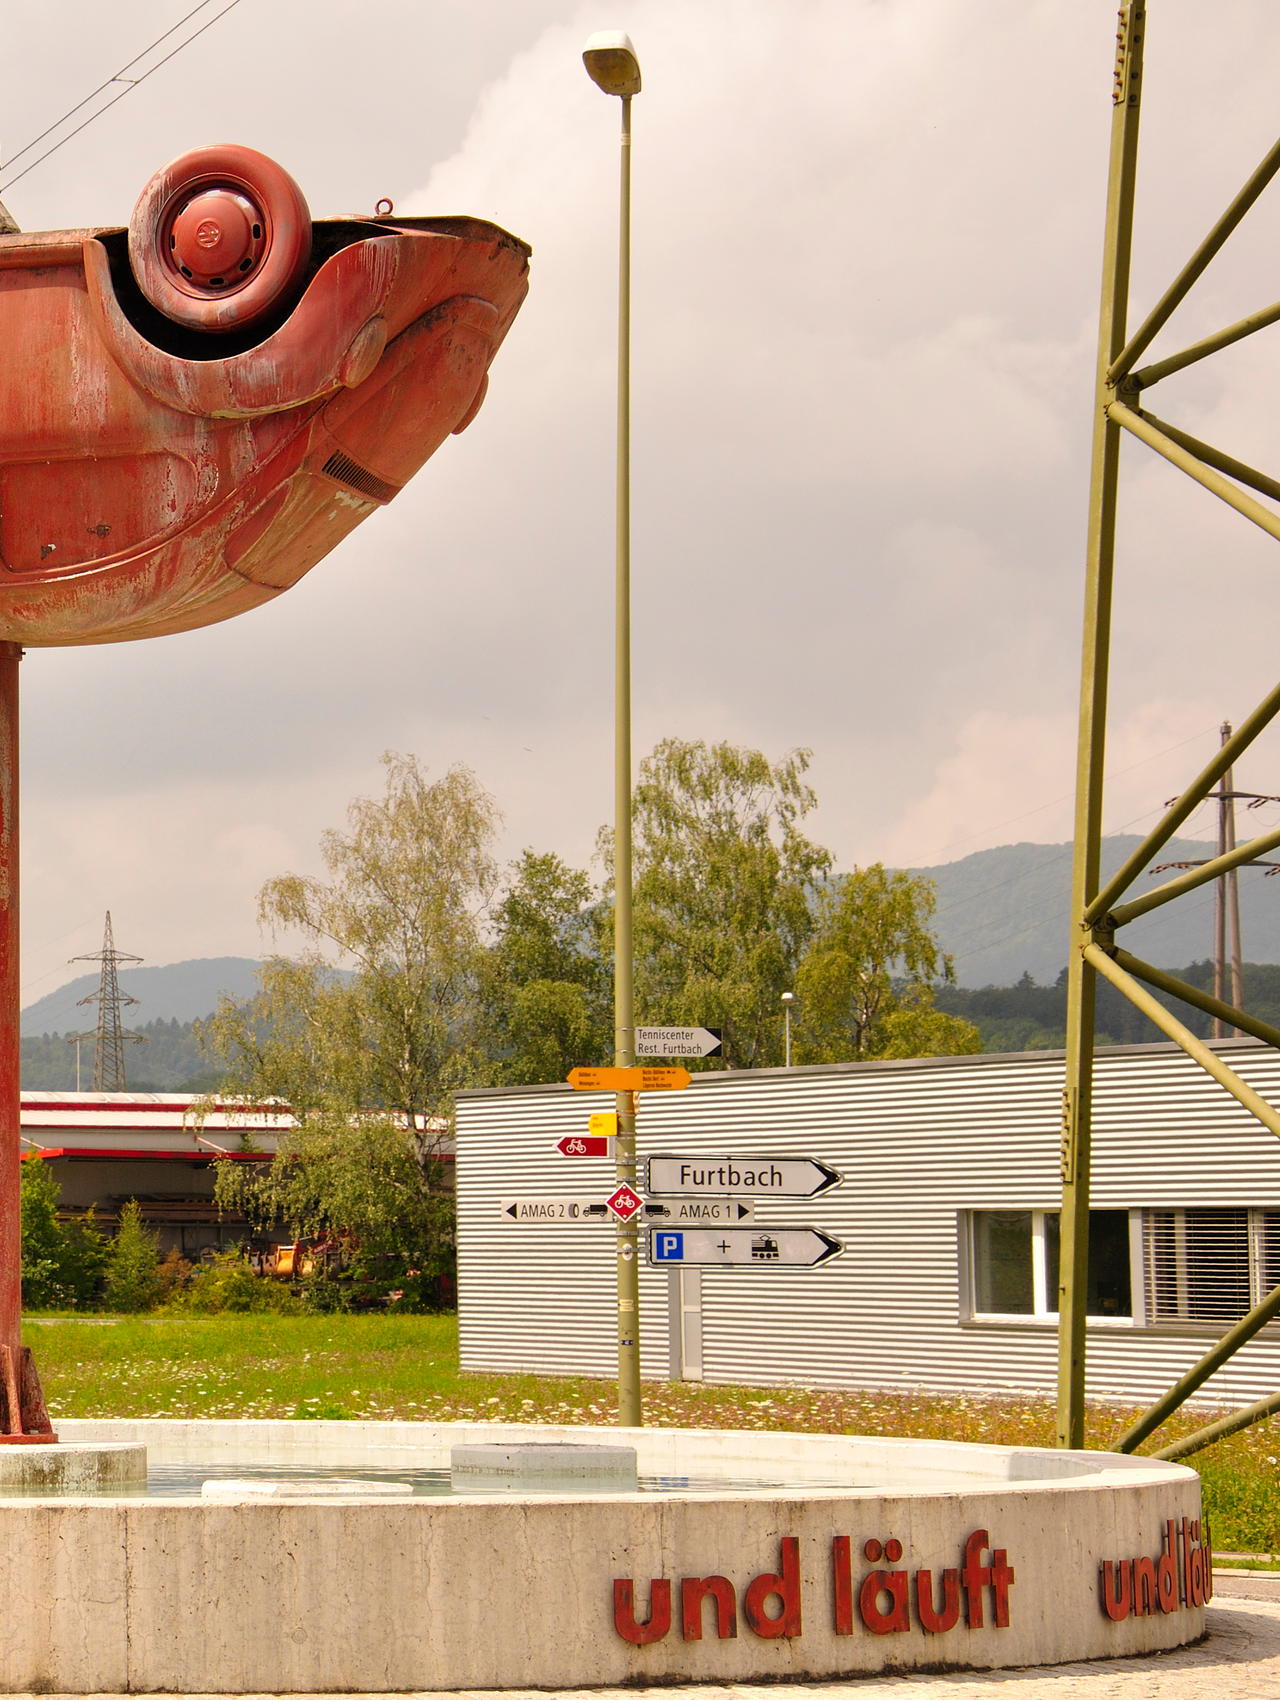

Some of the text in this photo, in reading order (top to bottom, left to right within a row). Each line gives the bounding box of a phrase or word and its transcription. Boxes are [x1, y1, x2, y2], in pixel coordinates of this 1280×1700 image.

[638, 1029, 694, 1040] Tenniscenter
[638, 1043, 702, 1054] Rest. Furtbach
[681, 1164, 783, 1187] Furtbach
[520, 1204, 565, 1218] AMAG 2
[679, 1204, 731, 1219] AMAG 1
[663, 1236, 677, 1257] P
[1103, 1519, 1178, 1622] und
[613, 1529, 1014, 1645] und läuft
